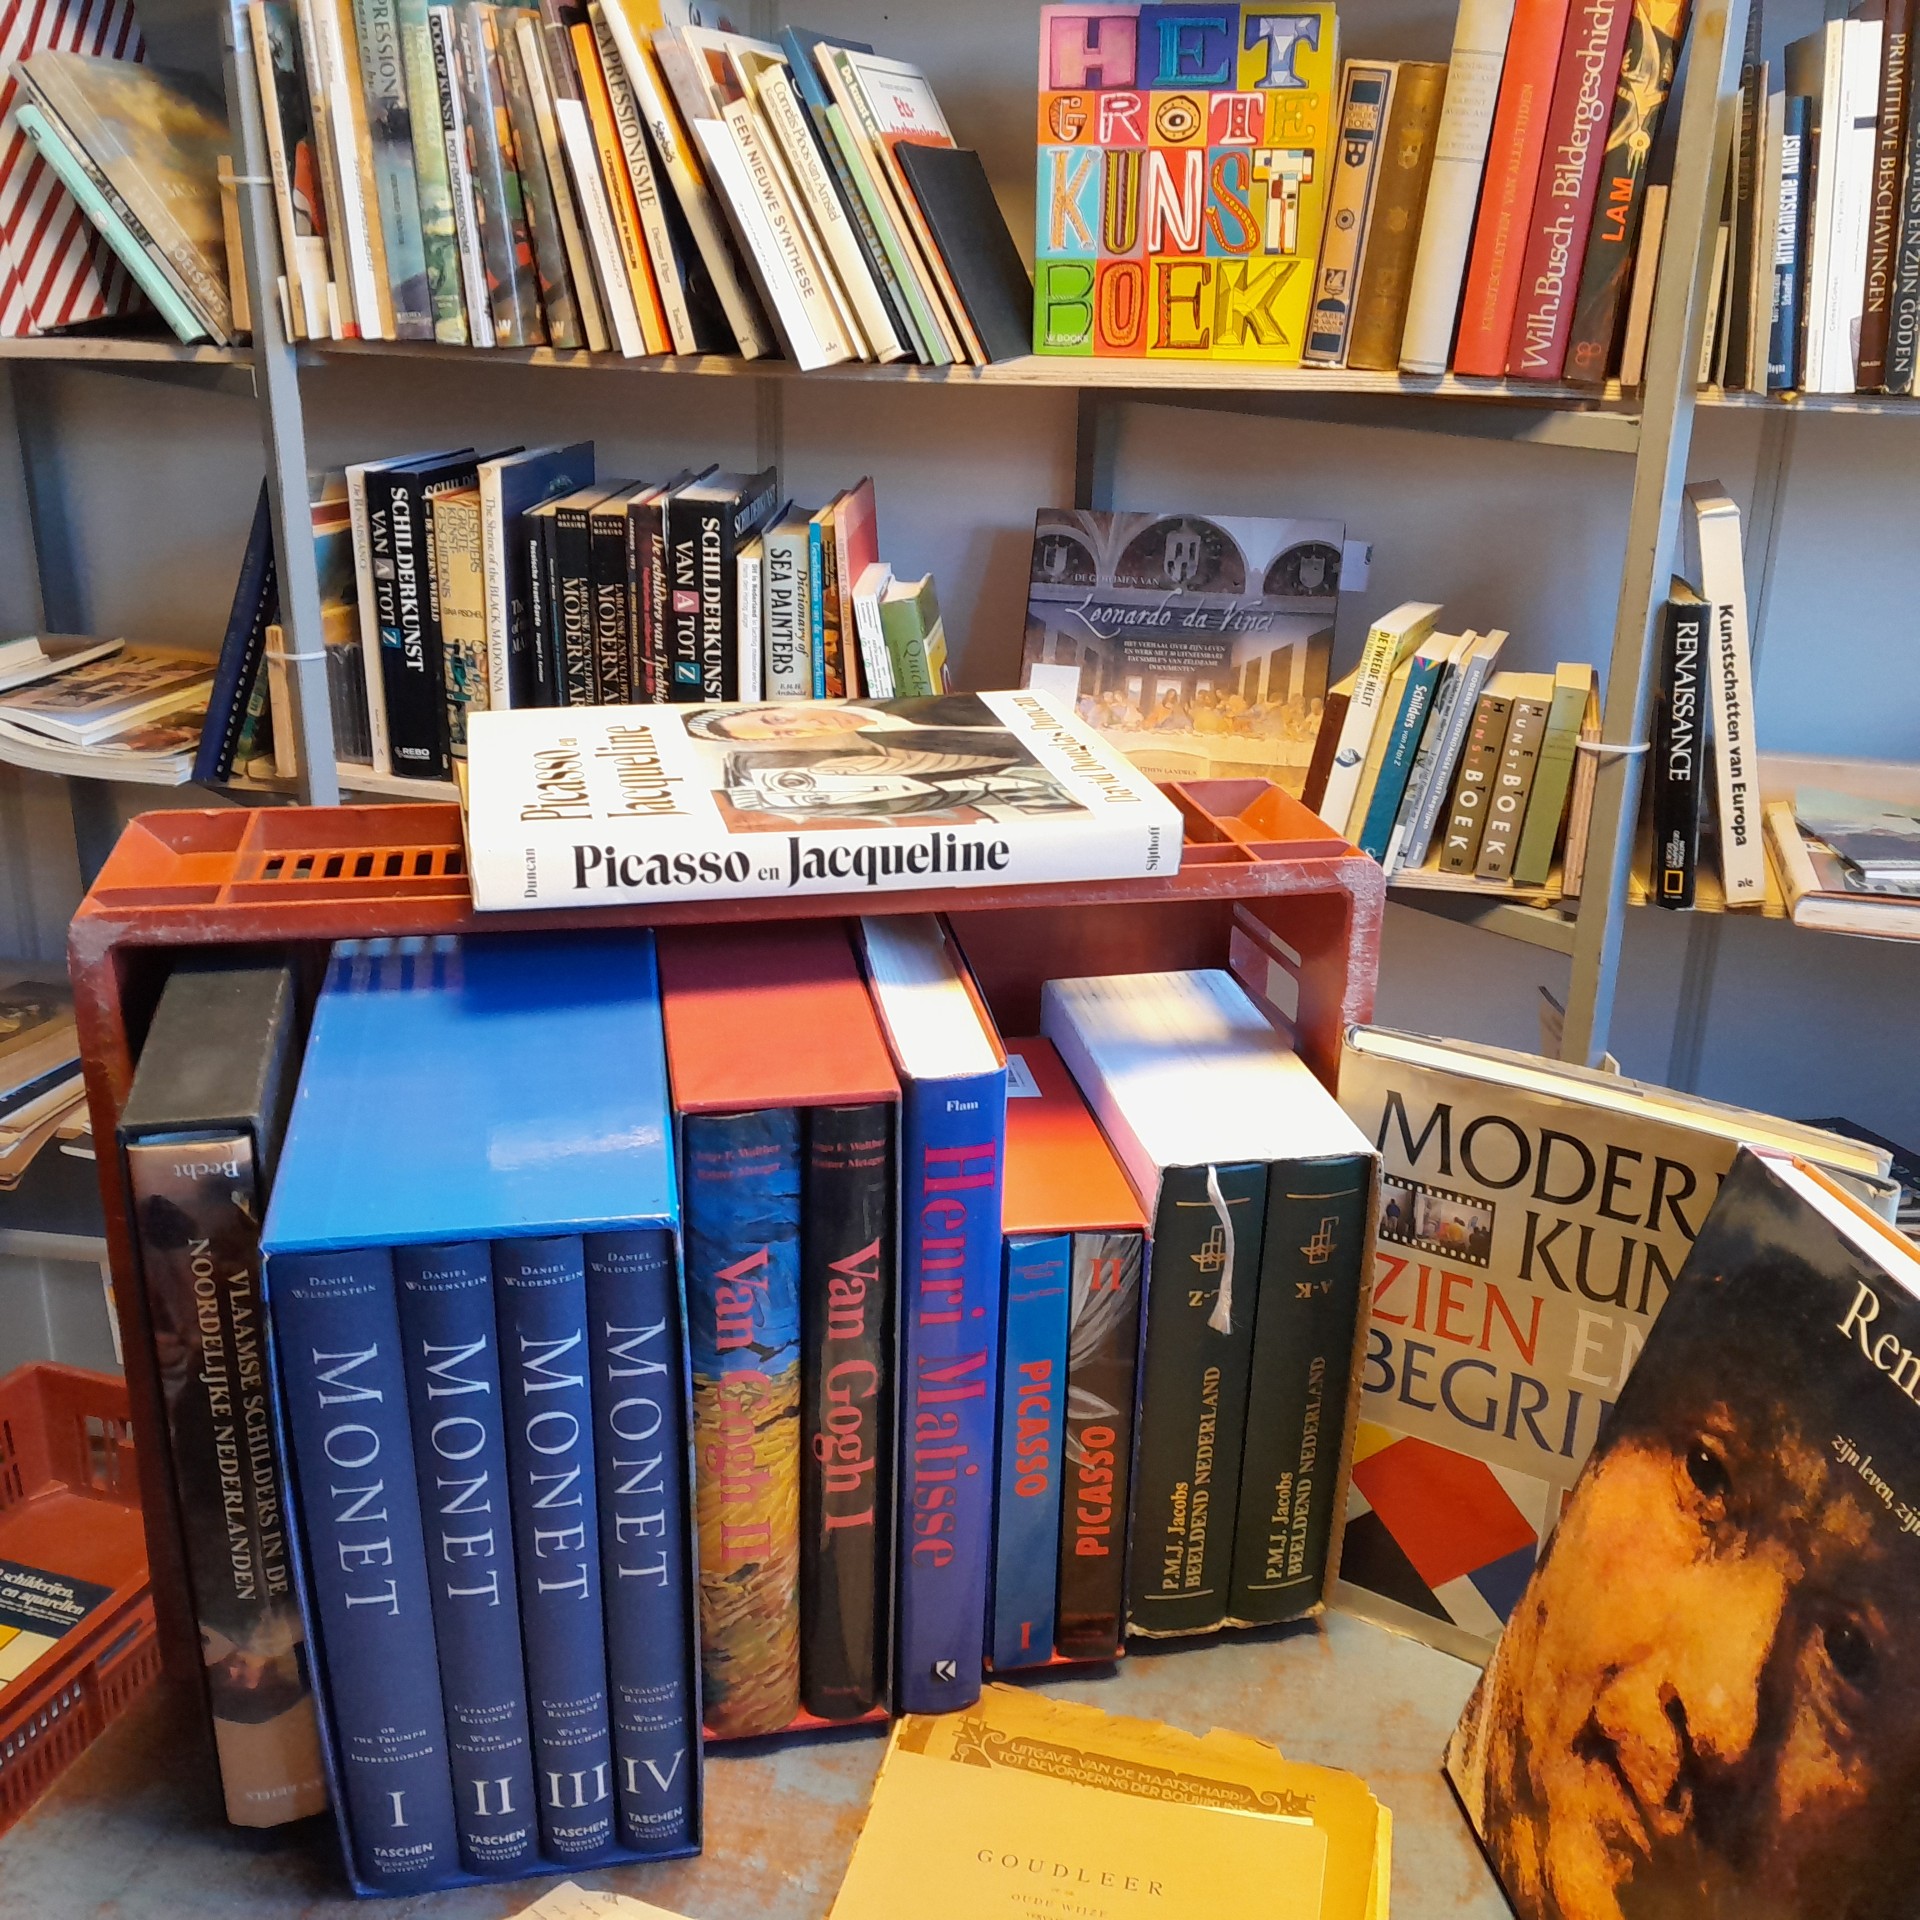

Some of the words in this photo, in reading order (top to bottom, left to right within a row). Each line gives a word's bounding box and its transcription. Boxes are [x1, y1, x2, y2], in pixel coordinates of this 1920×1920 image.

[1050, 14, 1321, 89] HET
[593, 19, 656, 209] EXPRESSIONISME
[1880, 31, 1906, 152] PRIMITIEVE
[1049, 92, 1318, 145] GROTE
[731, 114, 754, 147] EEN
[745, 149, 781, 213] NIEUWE
[771, 213, 815, 299] SYNTHESE
[1046, 148, 1315, 256] KUNST
[1602, 177, 1634, 242] LAM
[1866, 156, 1896, 315] BESCHAVINGEN
[1898, 249, 1919, 295] ZIJN
[1042, 261, 1301, 349] BOEK
[1893, 297, 1915, 373] GODEN
[370, 509, 389, 555] VAN
[484, 496, 494, 517] The
[435, 505, 452, 598] GESCHIEDENIS
[466, 508, 481, 572] ELSEVIERS
[486, 518, 497, 550] Shrine
[650, 532, 661, 554] De
[374, 559, 390, 578] A
[389, 485, 424, 673] SCHILDERKUNST
[487, 564, 497, 583] the
[651, 555, 666, 621] schilders
[674, 539, 694, 586] VAN
[769, 546, 793, 583] SEA
[811, 541, 822, 601] Geschiedenis
[1140, 576, 1160, 586] VAN
[377, 581, 395, 627] TOT
[489, 584, 500, 624] BLACK
[561, 574, 584, 676] MODERN
[677, 592, 694, 609] A
[701, 516, 721, 703] SCHILDERKUNST
[750, 582, 758, 618] Nederland
[795, 568, 808, 642] Dictionary
[1065, 587, 1182, 639] Leonardo
[1182, 600, 1208, 630] da
[1219, 600, 1275, 632] Vinci
[381, 629, 397, 647] Z
[597, 581, 618, 683] MODERN
[654, 621, 663, 649] van
[677, 614, 697, 661] TOT
[769, 587, 794, 675] PAINTERS
[794, 642, 809, 658] of
[1377, 630, 1390, 644] DE
[491, 627, 503, 692] MADONNA
[678, 664, 695, 680] Z
[813, 636, 824, 696] schilderkunst
[1367, 644, 1386, 680] TWEEDE
[1717, 603, 1743, 742] Kunstschatten
[1360, 679, 1376, 707] HELFT
[1401, 683, 1428, 730] Schilders
[1461, 668, 1480, 705] MODERNE
[1668, 619, 1699, 781] RENAISSANCE
[402, 748, 430, 757] REBO
[1394, 750, 1404, 760] tot
[1399, 729, 1410, 743] van
[1440, 716, 1465, 769] HEDENDAAGSE
[1729, 745, 1742, 778] van
[520, 749, 593, 822] Picasso
[595, 725, 694, 819] Jacqueline
[1433, 769, 1447, 794] KUNST
[1729, 782, 1749, 846] Europa
[524, 848, 537, 899] Duncan
[572, 845, 751, 891] Picasso
[757, 866, 780, 882] en
[788, 832, 1009, 889] Jacqueline
[1146, 826, 1161, 871] Sijthoff
[946, 1098, 979, 1112] Flam
[172, 1160, 240, 1180] Becht
[1376, 1090, 1726, 1240] MODER
[607, 1251, 652, 1265] DANIEL
[920, 1140, 996, 1328] Henri
[309, 1274, 355, 1288] DANIEL
[404, 1275, 488, 1293] WILDENSTEIN
[422, 1268, 467, 1282] DANIEL
[504, 1269, 584, 1288] WILDENSTEIN
[521, 1263, 566, 1277] DANIEL
[590, 1257, 670, 1275] WILDENSTEIN
[827, 1236, 880, 1339] Van
[1091, 1258, 1124, 1291] II
[1296, 1279, 1333, 1299] A-K
[1519, 1211, 1679, 1317] KUN
[292, 1283, 376, 1300] WILDENSTEIN
[715, 1244, 769, 1350] Van
[1369, 1251, 1544, 1366] ZIEN
[225, 1268, 259, 1390] VLAAMSE
[185, 1235, 232, 1417] NOORDELIJKE
[212, 1422, 257, 1601] NEDERLANDEN
[1297, 1355, 1327, 1475] NEDERLAND
[1361, 1329, 1592, 1458] BEGRI
[705, 1370, 775, 1504] Gogh
[813, 1359, 878, 1492] Gogh
[1015, 1359, 1052, 1497] PICASSO
[1194, 1368, 1220, 1487] NEDERLAND
[242, 1393, 278, 1526] SCHILDERS
[423, 1333, 500, 1607] MONET
[519, 1327, 589, 1600] MONET
[605, 1316, 669, 1588] MONET
[911, 1346, 988, 1568] Matisse
[1832, 1434, 1860, 1466] zijn
[1858, 1455, 1895, 1510] leven,
[311, 1342, 400, 1616] MONET
[1075, 1426, 1115, 1557] PICASSO
[1270, 1470, 1295, 1526] Jacobs
[825, 1505, 873, 1532] I
[1167, 1480, 1190, 1535] Jacobs
[1287, 1478, 1313, 1577] BEELDEND
[259, 1528, 282, 1556] IN
[720, 1515, 771, 1566] II
[1161, 1537, 1182, 1591] P.M.J.
[1184, 1490, 1209, 1589] BEELDEND
[1264, 1526, 1288, 1581] P.M.J.
[1, 1587, 20, 1598] en
[18, 1592, 86, 1615] aquarellen
[264, 1563, 288, 1593] DE
[351, 1745, 433, 1763] IMPRESSIONISM
[622, 1748, 685, 1794] IV
[995, 1750, 1024, 1765] TOT
[1026, 1758, 1129, 1790] BEVORDERING
[1132, 1782, 1160, 1798] DER
[1009, 1742, 1072, 1765] UITGAVE
[1076, 1757, 1110, 1774] VAN
[1113, 1766, 1132, 1779] DE
[387, 1791, 409, 1827] I
[472, 1776, 516, 1816] II
[546, 1761, 610, 1809] III
[468, 1828, 526, 1846] TASCHEN
[552, 1818, 609, 1838] TASCHEN
[628, 1806, 683, 1824] TASCHEN
[373, 1842, 433, 1858] TASCHEN
[976, 1848, 1164, 1897] GOUDLEER
